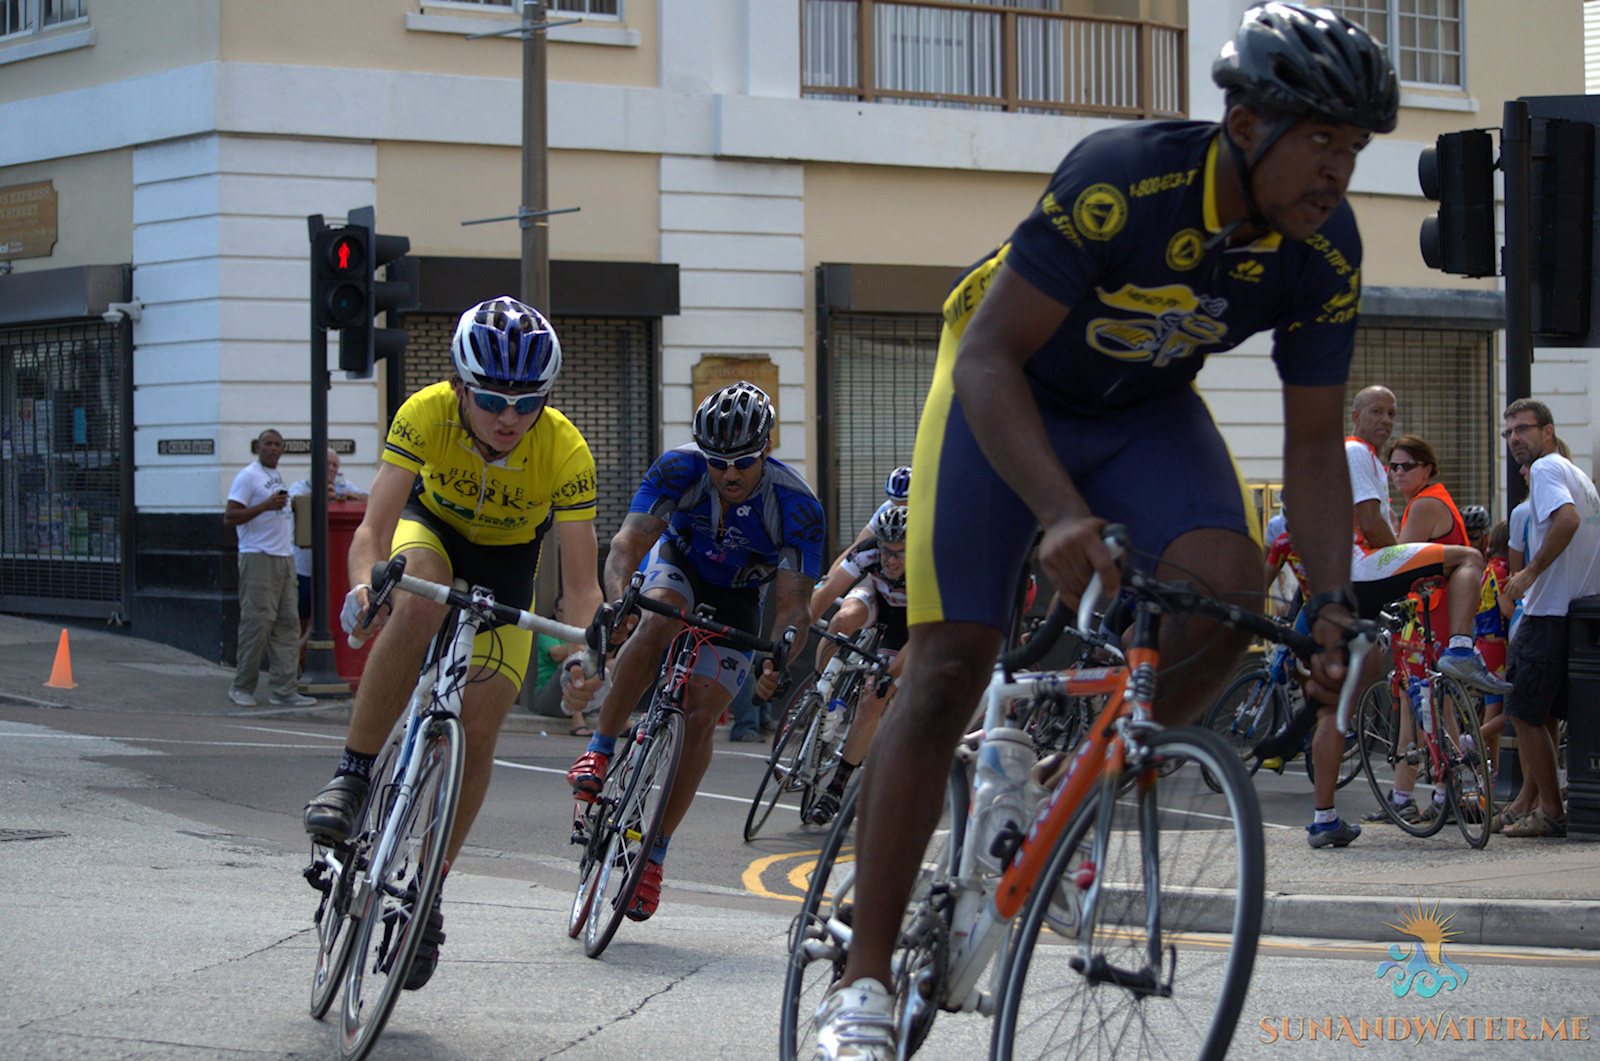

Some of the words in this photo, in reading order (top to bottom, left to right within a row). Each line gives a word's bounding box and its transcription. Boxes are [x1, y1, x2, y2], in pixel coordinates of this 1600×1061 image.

[10, 186, 50, 203] EXPRESS
[7, 203, 39, 218] STREET
[283, 440, 311, 452] UEEN
[449, 467, 525, 497] BICCLE
[429, 472, 543, 512] WORKS
